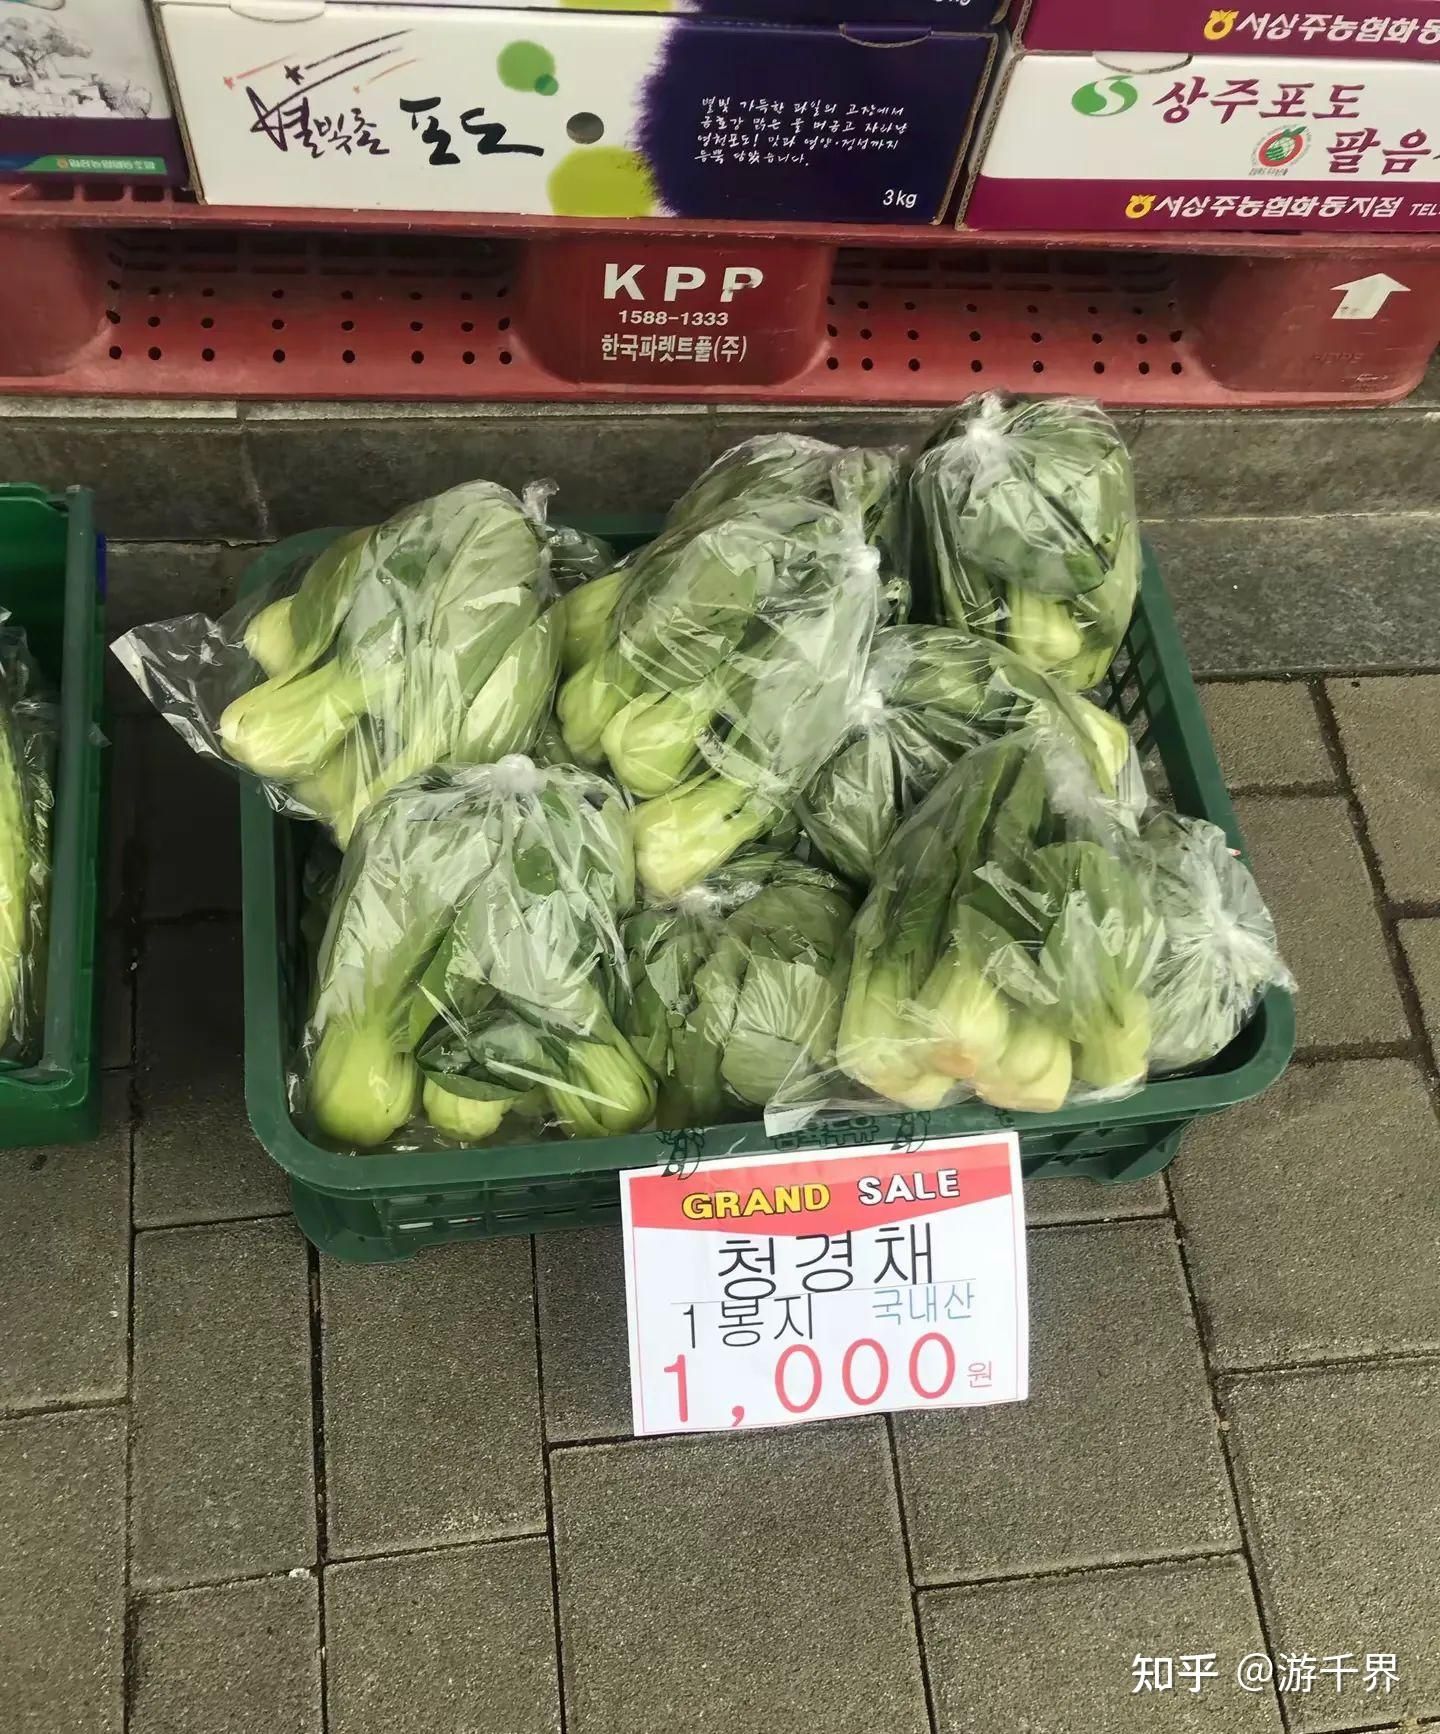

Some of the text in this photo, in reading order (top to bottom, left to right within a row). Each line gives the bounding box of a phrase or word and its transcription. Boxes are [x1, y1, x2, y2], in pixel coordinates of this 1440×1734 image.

[702, 97, 905, 117] 별빛 가득한 과일의 고장에서
[1153, 76, 1365, 124] 상주포도
[400, 97, 544, 165] 포도
[753, 117, 782, 132] 맑은
[791, 117, 804, 133] 물
[768, 135, 796, 148] 맛과
[1327, 128, 1440, 175] 팔음
[883, 190, 918, 209] 3kg
[1154, 195, 1404, 217] 서상주농협화동지점
[619, 310, 729, 326] 1588-1333
[602, 333, 747, 363] 한국파렛트풀(주)
[681, 1168, 961, 1220] GRAND SALE
[718, 1222, 933, 1300] 청경채
[872, 1282, 975, 1325] 국내산
[663, 1332, 993, 1428] 1,000 원
